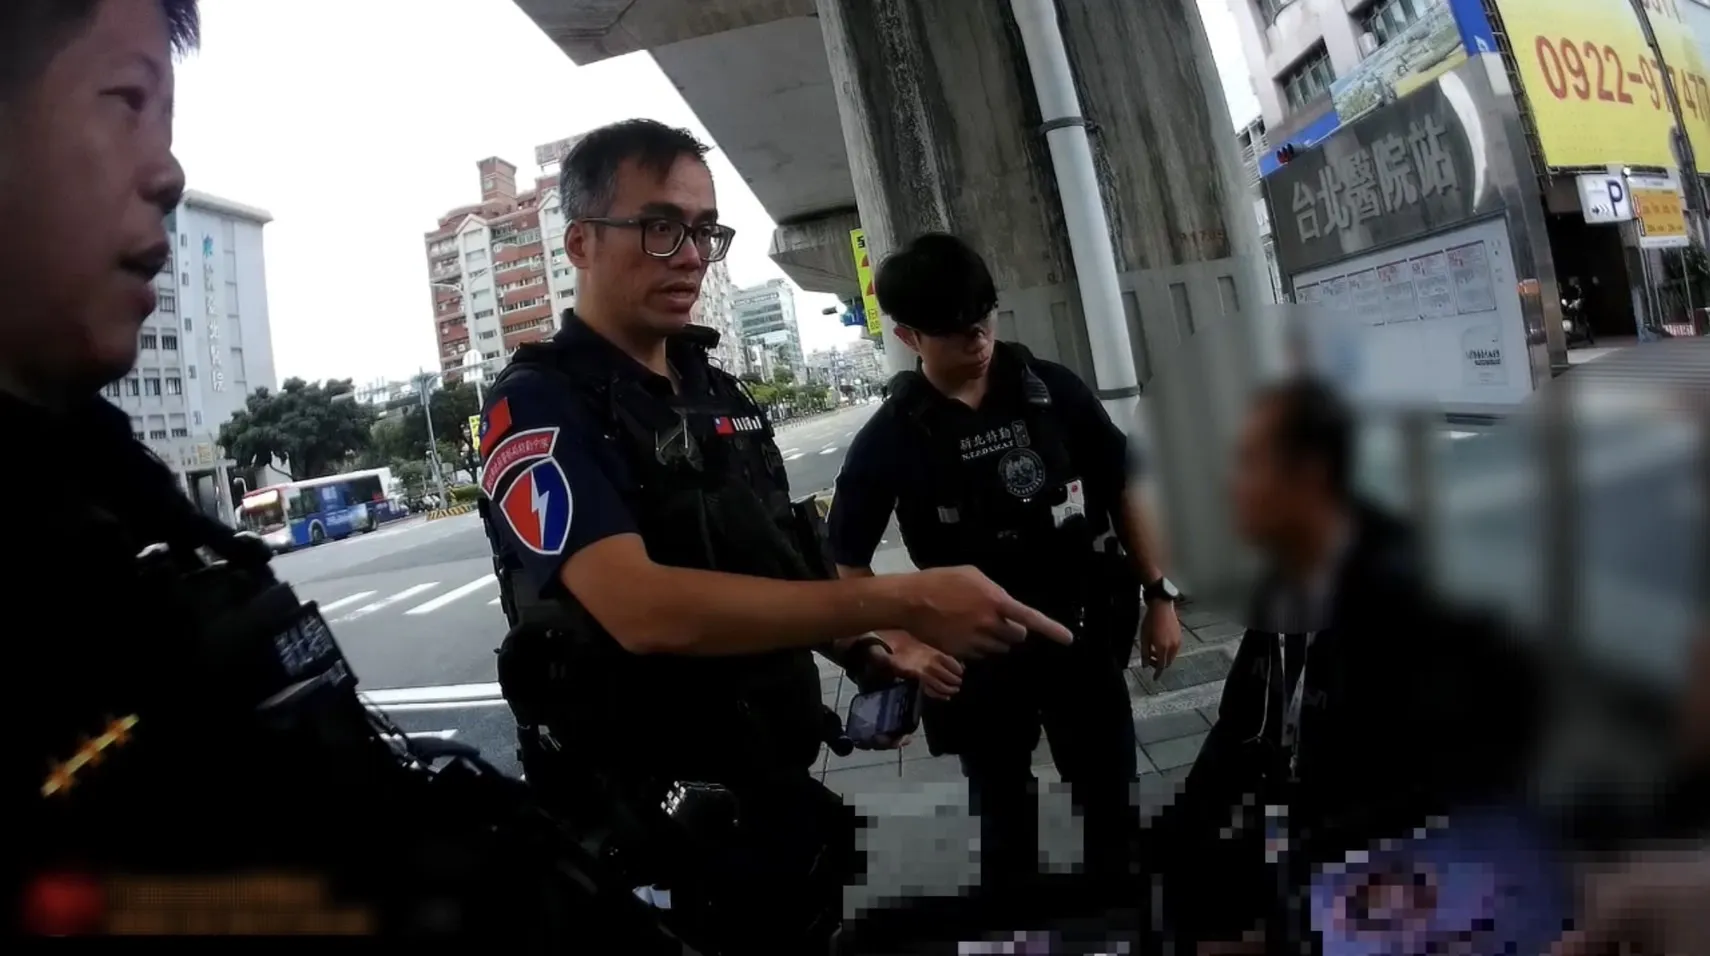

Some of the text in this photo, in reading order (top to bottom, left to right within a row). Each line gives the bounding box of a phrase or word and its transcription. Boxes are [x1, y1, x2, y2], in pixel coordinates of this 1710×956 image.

[1292, 114, 1459, 244] 台北醫院站
[1606, 179, 1623, 217] P
